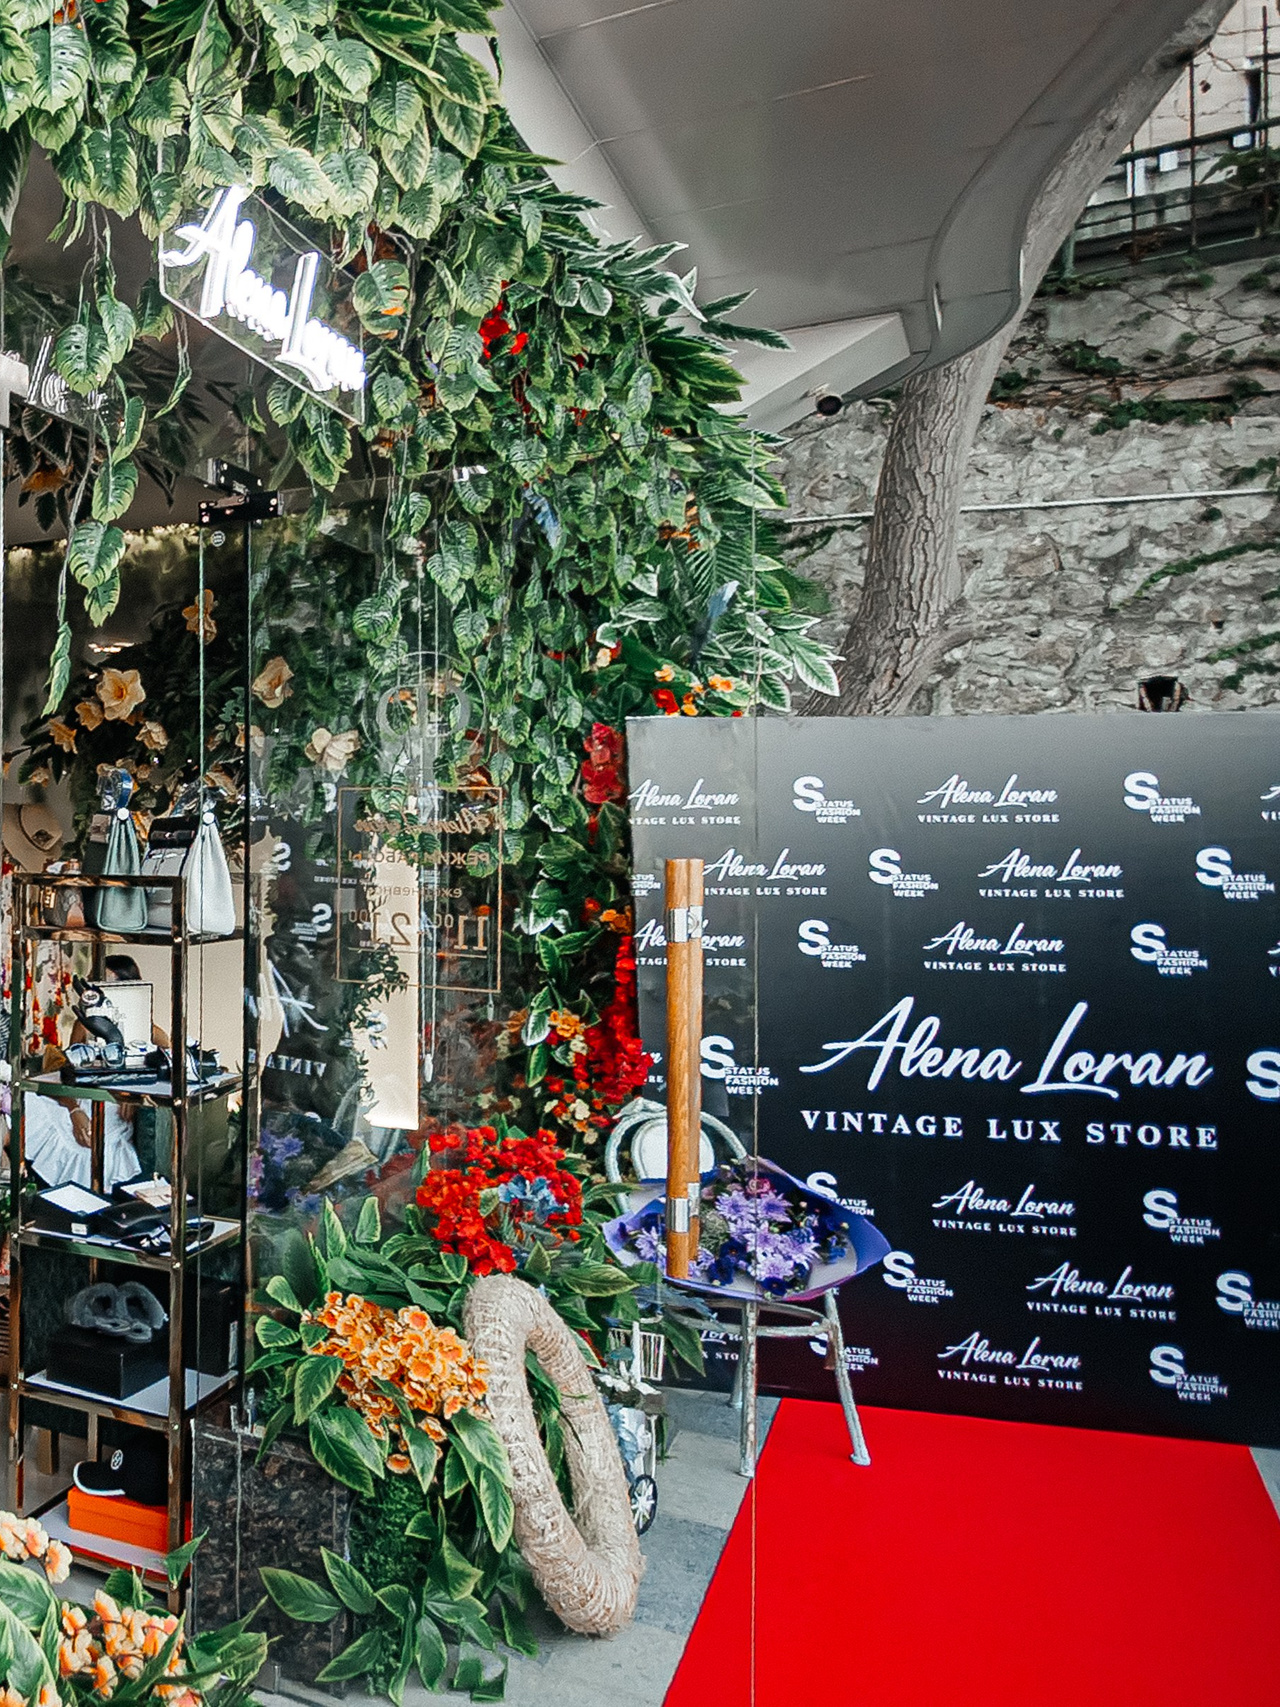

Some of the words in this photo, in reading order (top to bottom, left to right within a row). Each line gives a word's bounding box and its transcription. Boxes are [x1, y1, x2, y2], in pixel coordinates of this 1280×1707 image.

[627, 778, 685, 812] Alena
[681, 778, 740, 810] Loran
[792, 775, 825, 812] S
[917, 774, 995, 809] Alena
[992, 774, 1058, 808] Loran
[1123, 771, 1160, 811] S
[815, 800, 854, 808] STATUS
[1150, 797, 1193, 806] STATUS
[815, 807, 861, 816] FASHION
[1149, 805, 1201, 815] FASHION
[671, 816, 695, 825] LUX
[700, 815, 741, 825] STORE
[817, 815, 847, 824] WEEK
[917, 814, 976, 824] VINTAGE
[982, 814, 1008, 823] LUX
[1014, 814, 1060, 823] STORE
[1151, 814, 1185, 823] WEEK
[702, 848, 767, 882] Alena
[765, 848, 827, 881] Loran
[868, 848, 902, 885] S
[978, 848, 1058, 883] Alena
[1055, 848, 1124, 883] Loran
[1195, 847, 1233, 887] S
[892, 873, 932, 882] STATUS
[1222, 874, 1267, 883] STATUS
[705, 886, 750, 896] INTAGE
[756, 886, 781, 896] LUX
[786, 886, 828, 896] STORE
[892, 881, 939, 891] FASHION
[1222, 882, 1275, 892] FASHION
[894, 888, 925, 898] WEEK
[978, 888, 1038, 898] VINTAGE
[1044, 888, 1071, 899] LUX
[1078, 888, 1126, 899] STORE
[1224, 890, 1259, 900] WEEK
[633, 918, 667, 953] Ale
[701, 919, 746, 952] oran
[797, 918, 831, 956] S
[922, 921, 1002, 956] Alena
[999, 922, 1065, 957] Loran
[1130, 923, 1167, 963] S
[820, 944, 859, 954] STATUS
[1157, 949, 1200, 959] STATUS
[705, 957, 747, 967] STORE
[820, 953, 867, 962] FASHION
[1156, 957, 1209, 968] FASHION
[822, 960, 853, 969] WEEK
[923, 961, 983, 972] VINTAGE
[988, 962, 1015, 972] LUX
[1021, 962, 1067, 973] STORE
[1157, 966, 1193, 977] WEEK
[799, 995, 1022, 1092] Alena
[1019, 1000, 1215, 1100] Loran
[699, 1034, 736, 1080] S
[725, 1066, 771, 1076] STATUS
[725, 1075, 780, 1087] FASHION
[726, 1085, 763, 1096] WEEK
[800, 1109, 964, 1139] VINTAGE
[987, 1118, 1062, 1143] LUX
[1085, 1121, 1219, 1151] STORE
[931, 1179, 1013, 1216] Alena
[1009, 1183, 1076, 1219] Loran
[1142, 1189, 1179, 1229] S
[932, 1218, 992, 1232] VINTAGE
[998, 1222, 1026, 1234] LUX
[1032, 1225, 1078, 1237] STORE
[1169, 1217, 1213, 1228] STATUS
[1169, 1226, 1221, 1238] FASHION
[1170, 1234, 1205, 1245] WEEK
[882, 1250, 916, 1288] S
[906, 1278, 947, 1288] STATUS
[1025, 1261, 1109, 1298] Alena
[1106, 1265, 1176, 1304] Loran
[906, 1286, 954, 1297] FASHION
[1215, 1272, 1253, 1312] S
[907, 1294, 940, 1304] WEEK
[1242, 1300, 1280, 1309] STATU
[1026, 1301, 1088, 1315] VINTAGE
[1094, 1306, 1123, 1317] LUX
[1129, 1308, 1178, 1321] STORE
[937, 1331, 1018, 1367] Alena
[1015, 1336, 1083, 1373] Loran
[1149, 1345, 1186, 1385] S
[937, 1369, 998, 1384] VINTAGE
[1004, 1375, 1031, 1387] LUX
[1037, 1377, 1084, 1391] STORE
[1176, 1374, 1220, 1384] STATUS
[1176, 1382, 1229, 1396] FASHION
[1177, 1390, 1212, 1401] WEEK
